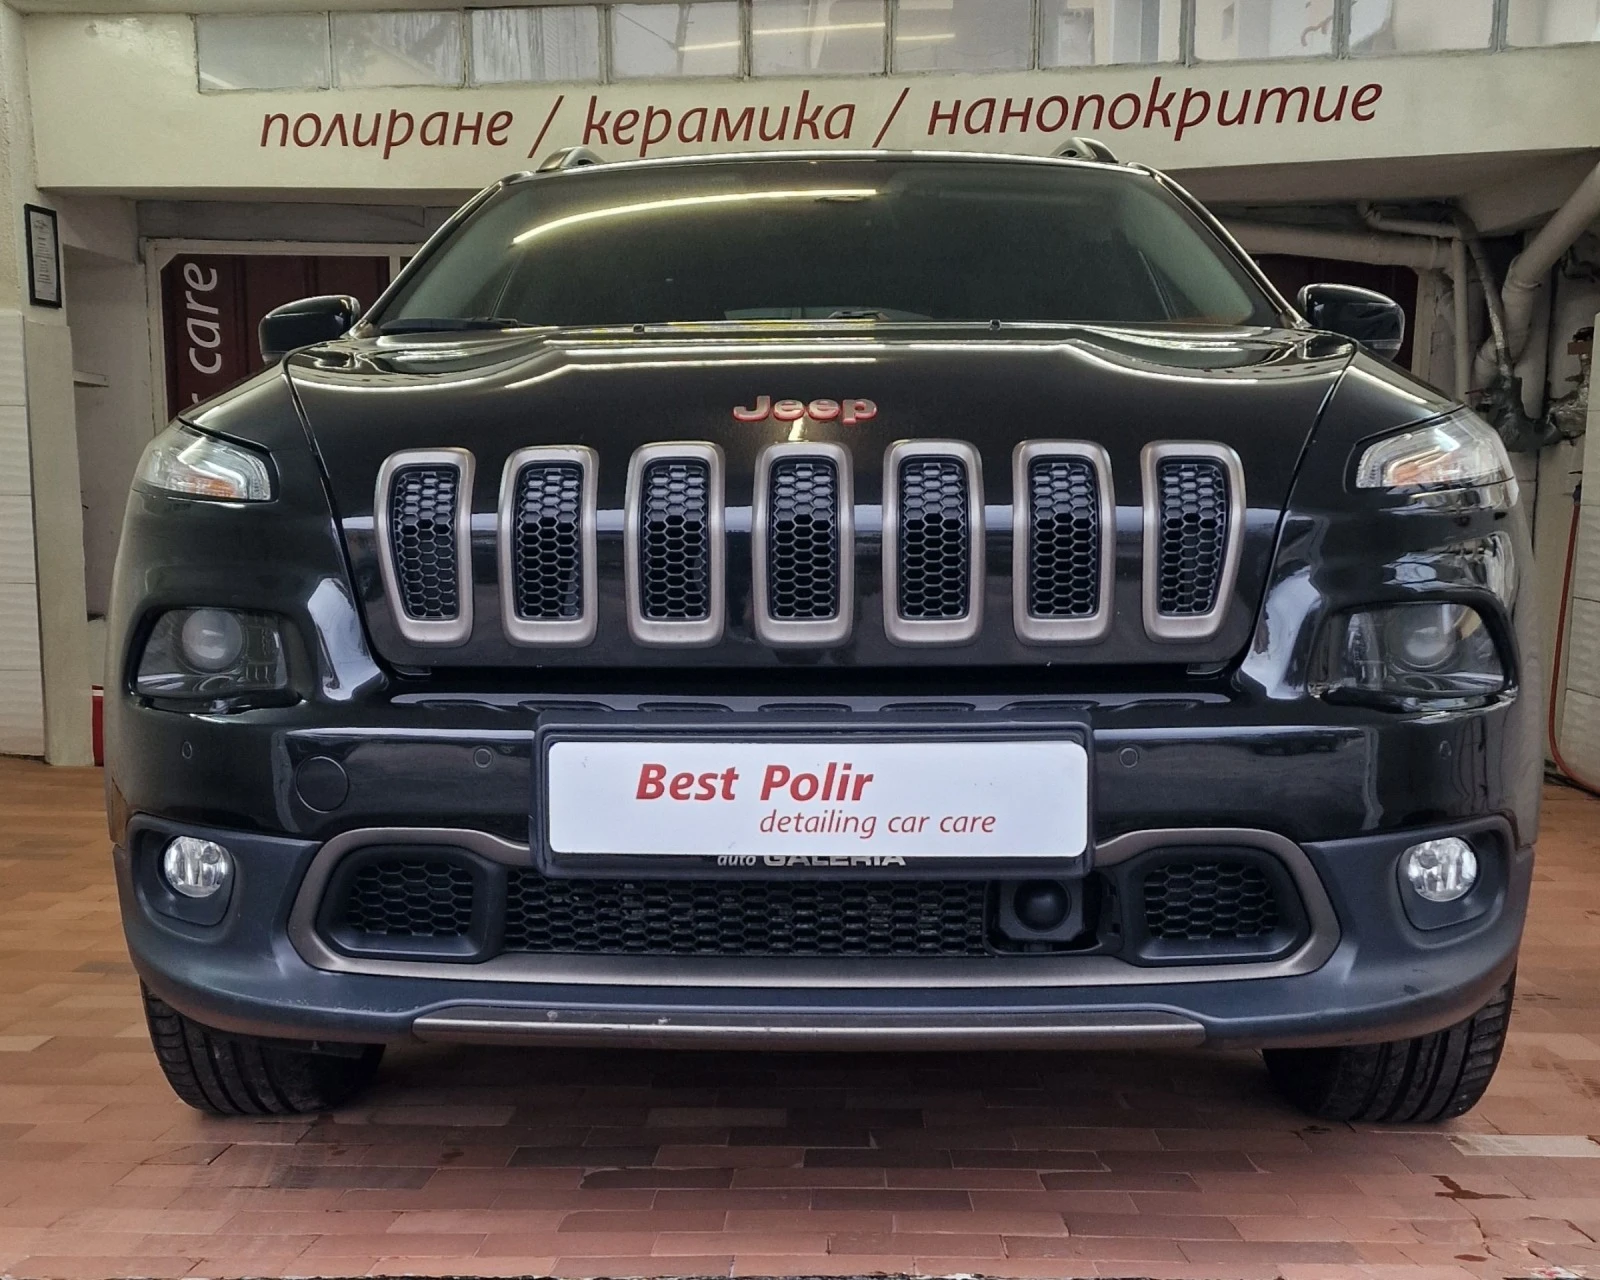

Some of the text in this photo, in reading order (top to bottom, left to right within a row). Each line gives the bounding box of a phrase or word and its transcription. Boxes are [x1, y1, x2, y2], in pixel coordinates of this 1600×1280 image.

[260, 109, 513, 160] полиране
[581, 90, 856, 158] керамика
[927, 77, 1382, 142] нанопокритие
[183, 262, 222, 374] care
[732, 395, 878, 425] Jeep
[635, 763, 874, 802] Best Polir
[760, 809, 997, 839] detailing car care
[717, 855, 907, 867] auto GALERIA
